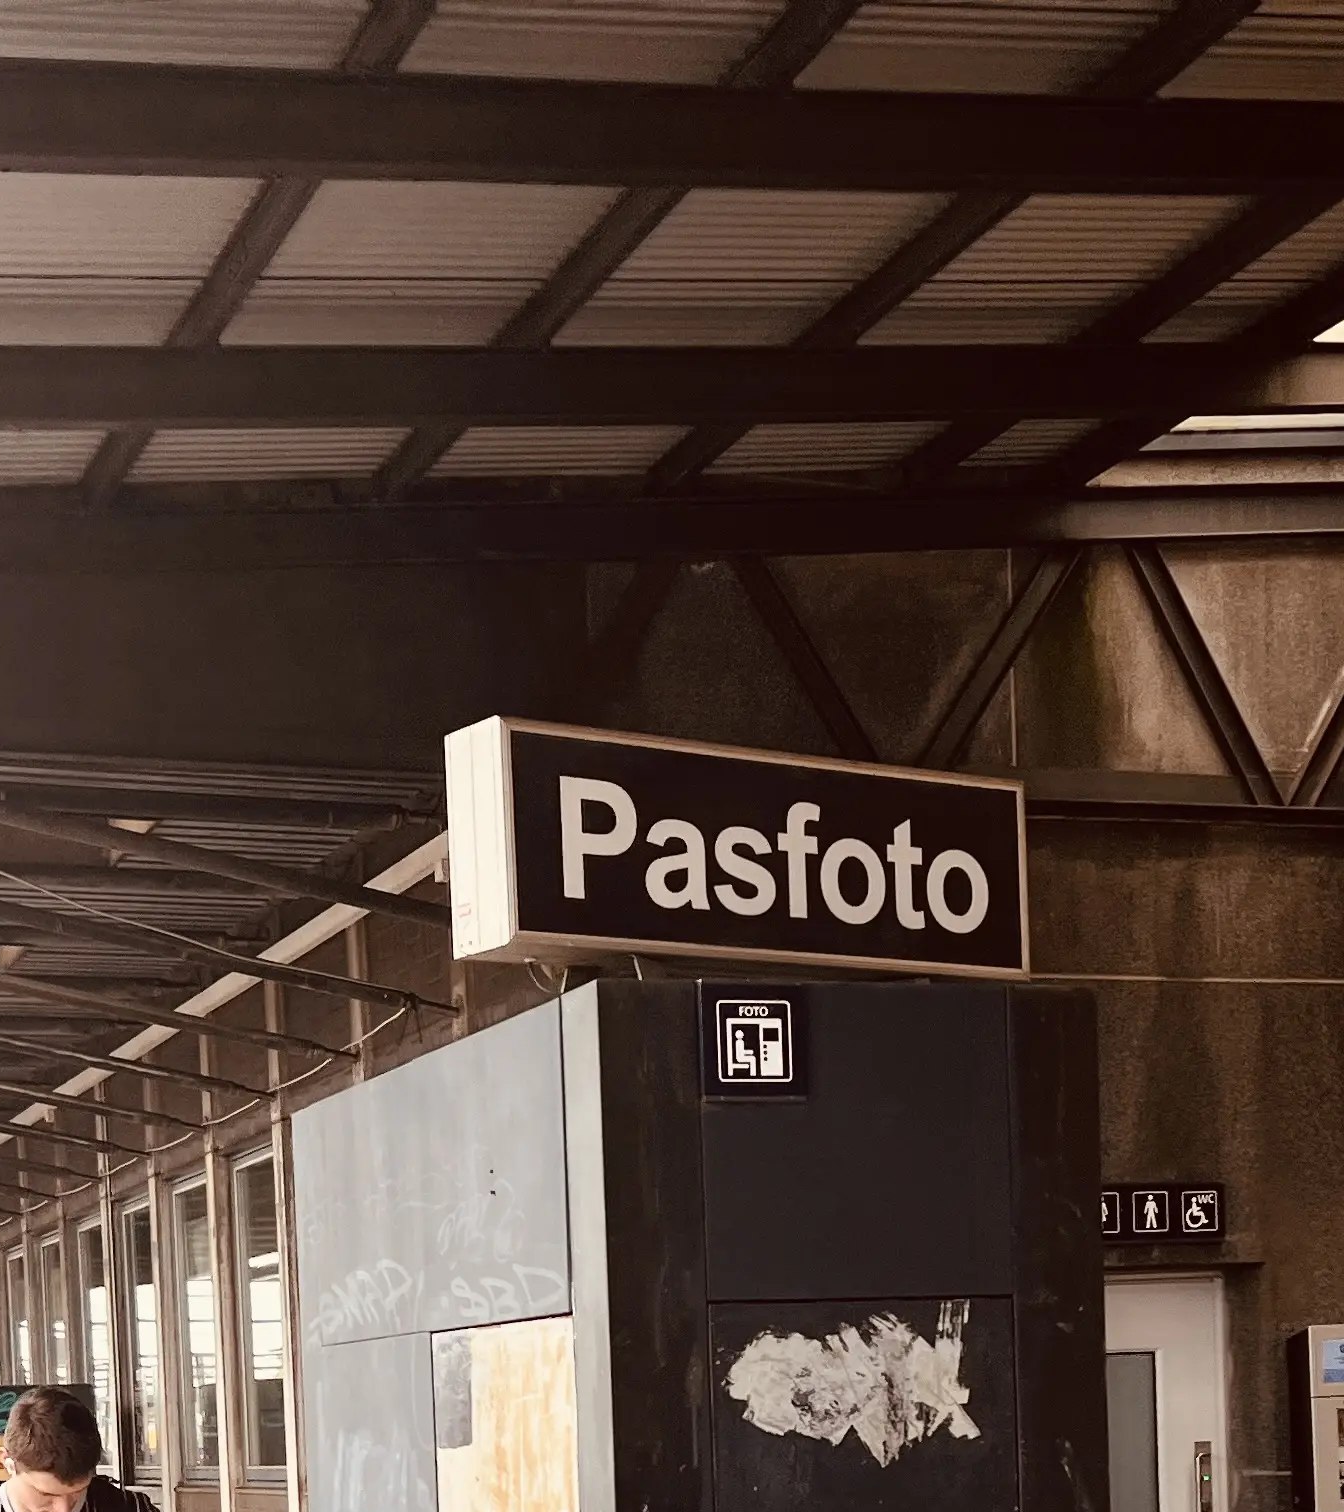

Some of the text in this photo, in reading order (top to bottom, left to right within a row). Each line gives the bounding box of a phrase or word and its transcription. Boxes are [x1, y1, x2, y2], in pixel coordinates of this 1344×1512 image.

[559, 775, 990, 934] Pasfoto
[738, 1005, 769, 1017] FOTO
[1197, 1193, 1215, 1205] WC
